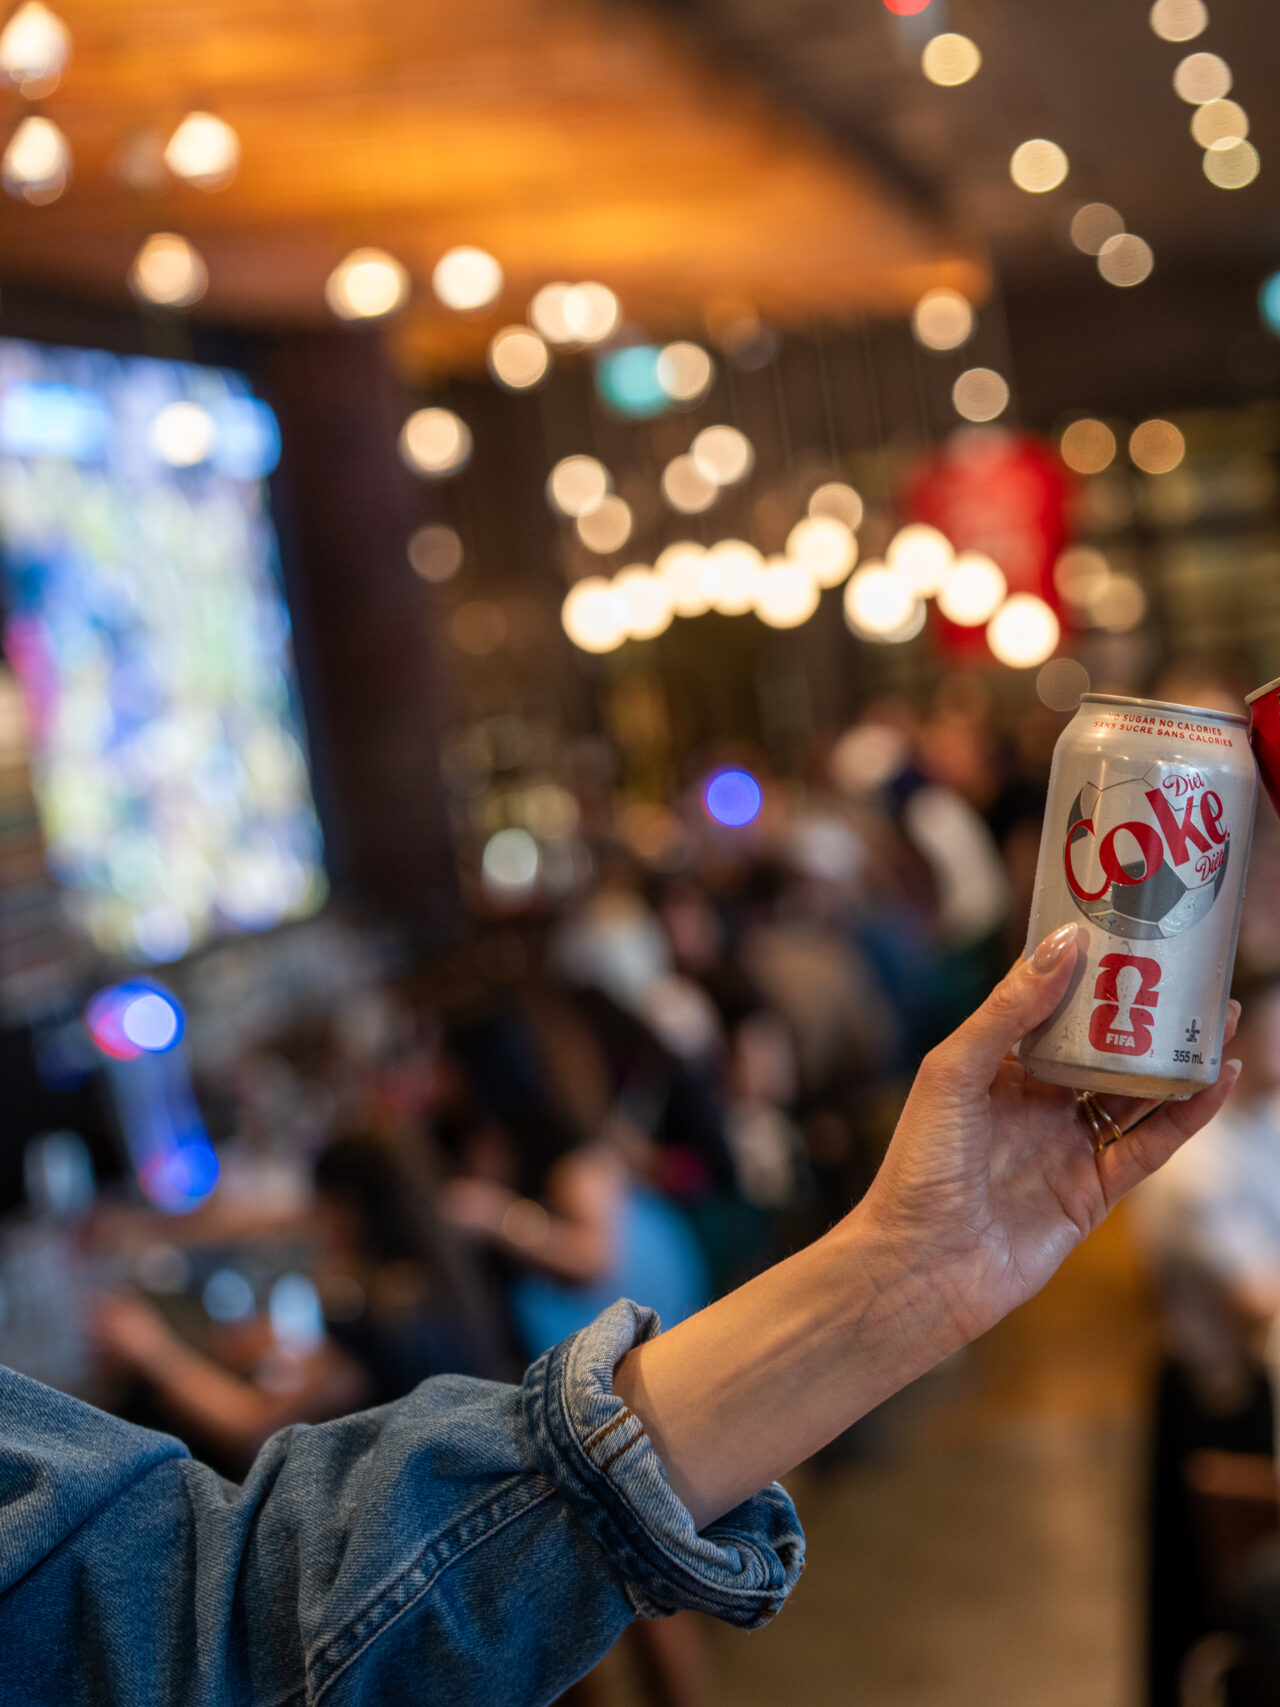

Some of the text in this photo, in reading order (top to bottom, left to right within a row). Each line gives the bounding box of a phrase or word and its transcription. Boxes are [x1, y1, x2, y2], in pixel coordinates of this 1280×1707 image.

[1093, 720, 1233, 747] SANS SUCRE SANS CALORIES
[1123, 714, 1156, 725] SUGAR
[1159, 719, 1174, 728] NO
[1177, 722, 1222, 736] CALORIES
[1162, 772, 1205, 797] Diet
[1064, 788, 1228, 902] Coke
[1105, 1032, 1136, 1048] FIFA
[1172, 1050, 1191, 1063] 355
[1191, 1052, 1203, 1064] mL
